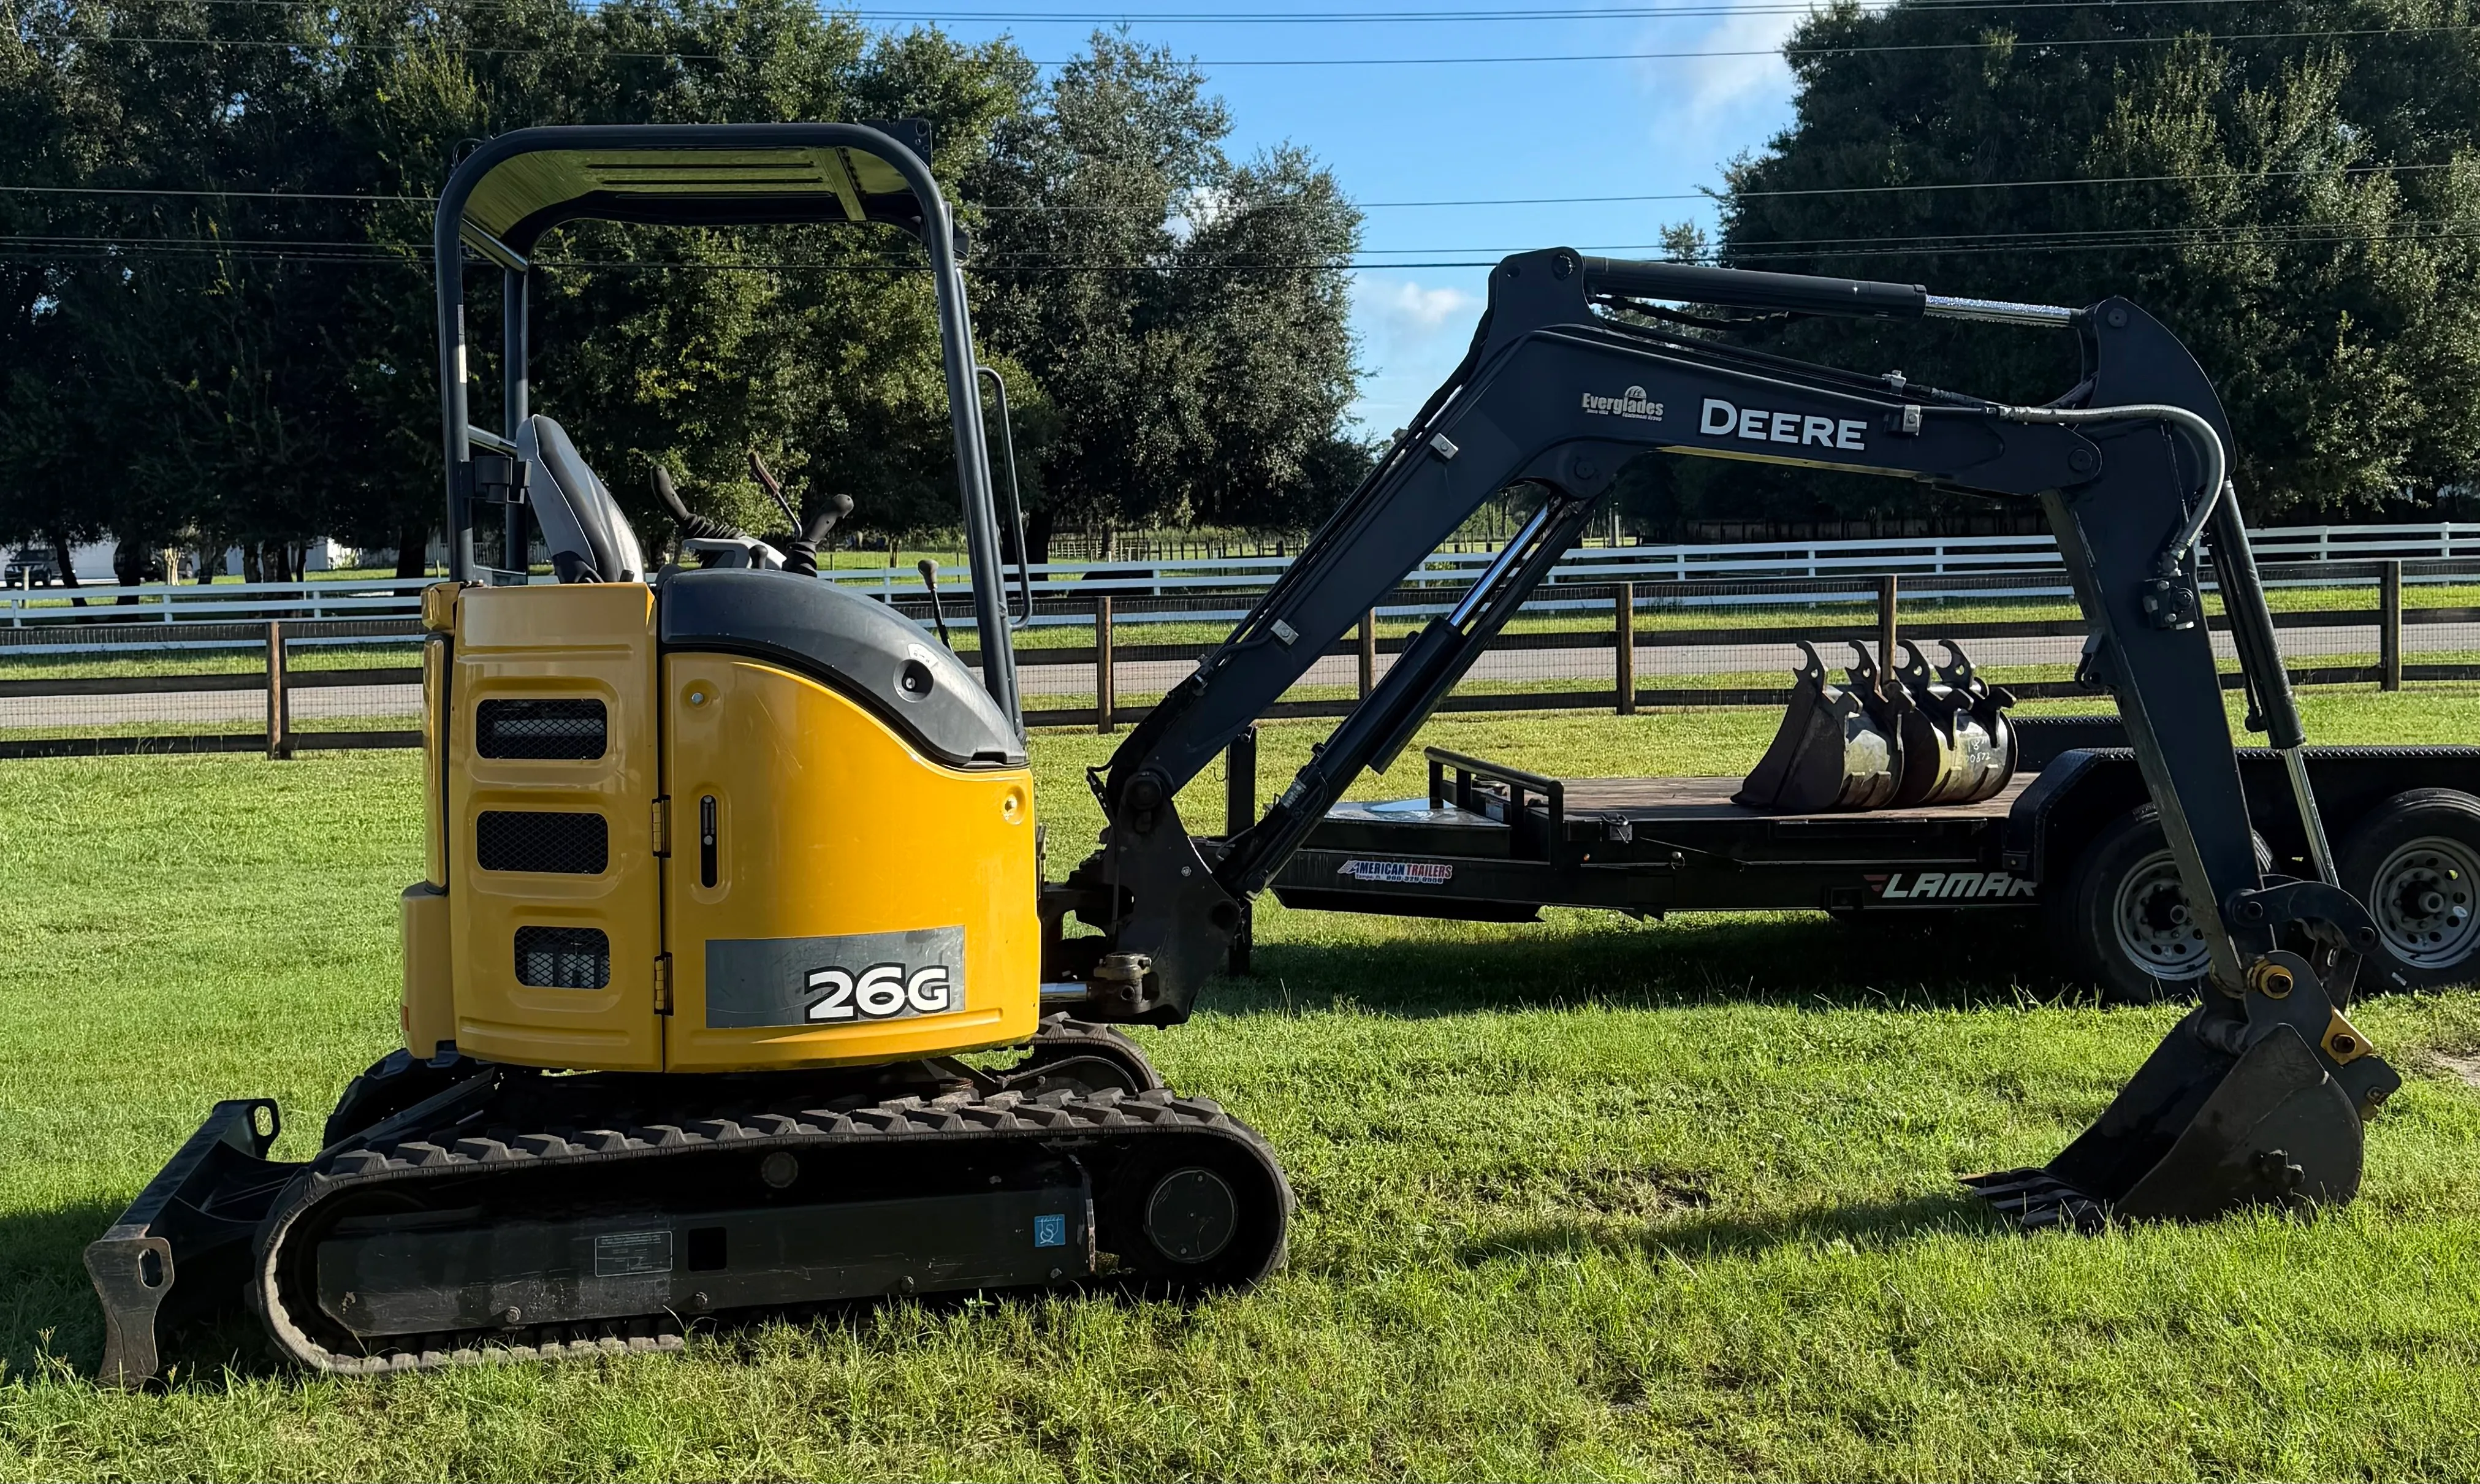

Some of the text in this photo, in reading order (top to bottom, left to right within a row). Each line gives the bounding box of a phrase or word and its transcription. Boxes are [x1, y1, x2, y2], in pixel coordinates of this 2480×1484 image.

[1581, 392, 1664, 416] Everglades
[1700, 398, 1868, 451] DEERE
[1347, 860, 1451, 878] AMERICAN TRAILERS
[805, 963, 950, 1023] 26G
